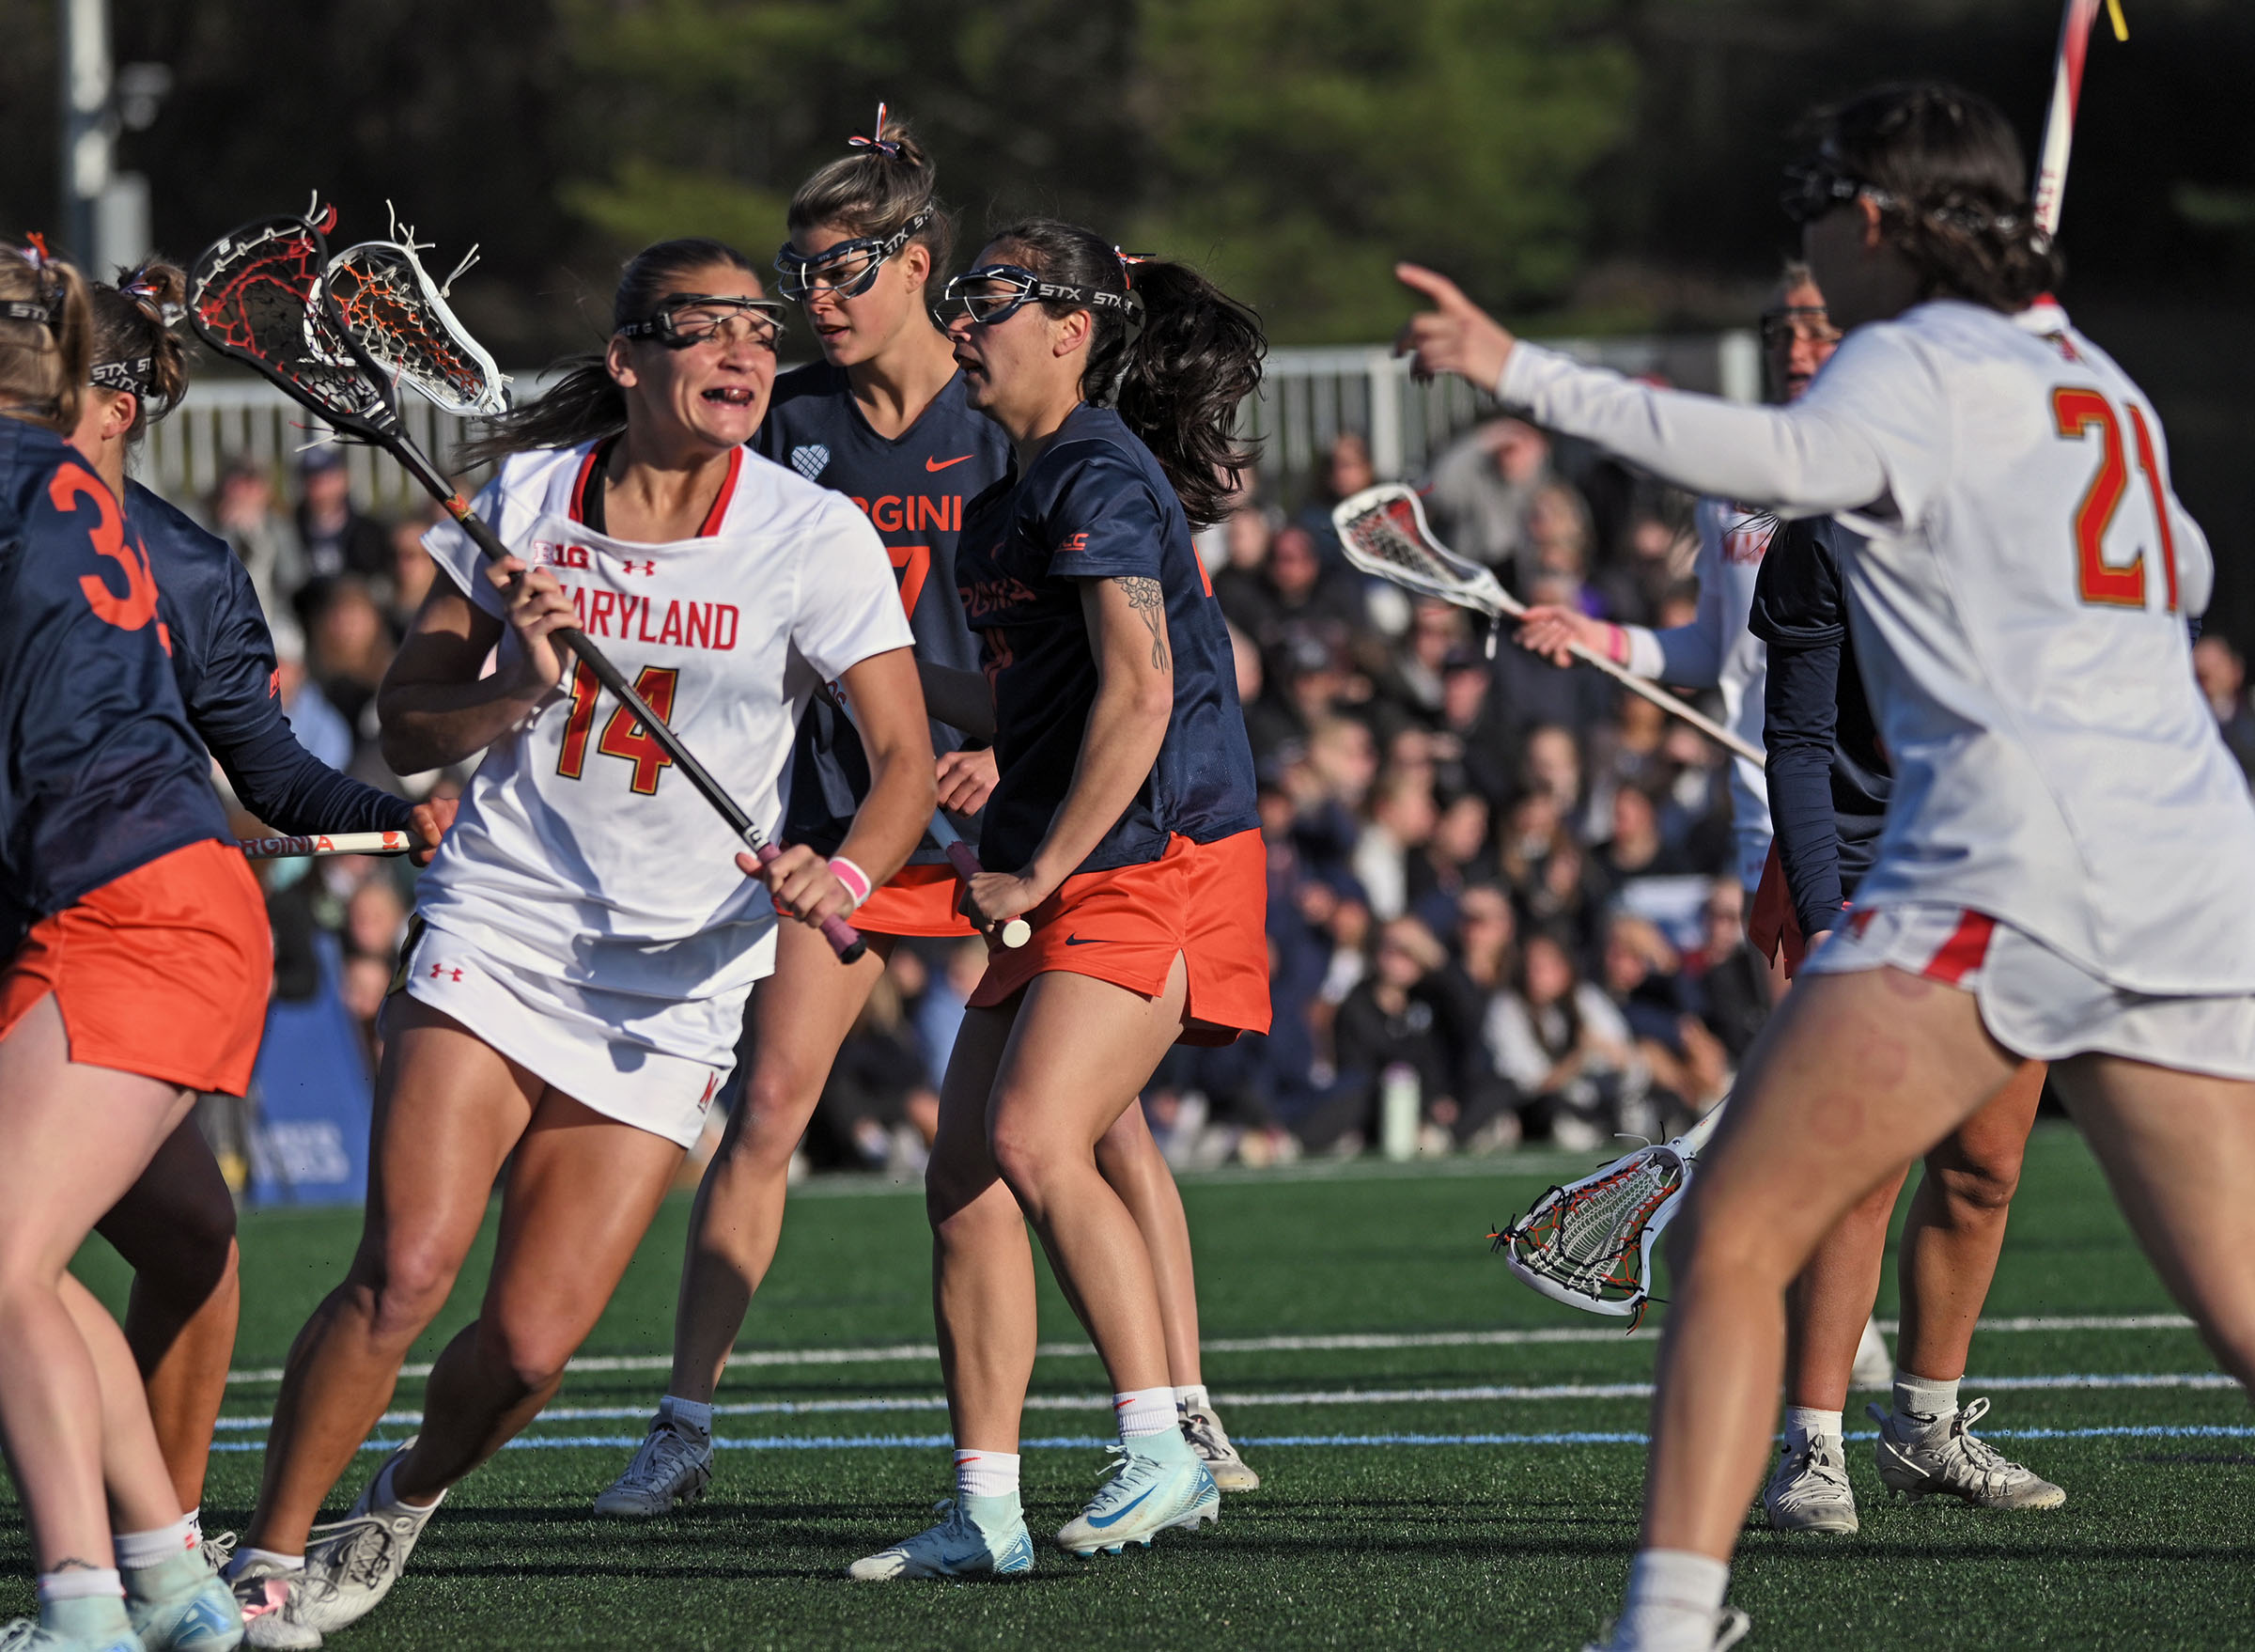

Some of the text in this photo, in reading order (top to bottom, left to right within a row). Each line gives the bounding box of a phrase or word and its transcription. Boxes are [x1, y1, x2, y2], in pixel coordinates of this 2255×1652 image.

[883, 227, 909, 254] STX
[1039, 284, 1081, 301] STX
[1093, 291, 1122, 308] STX
[91, 362, 128, 380] STX
[137, 357, 151, 372] ST
[2052, 386, 2177, 613] 21
[559, 584, 739, 651] ARYLAND
[556, 660, 679, 795] 14
